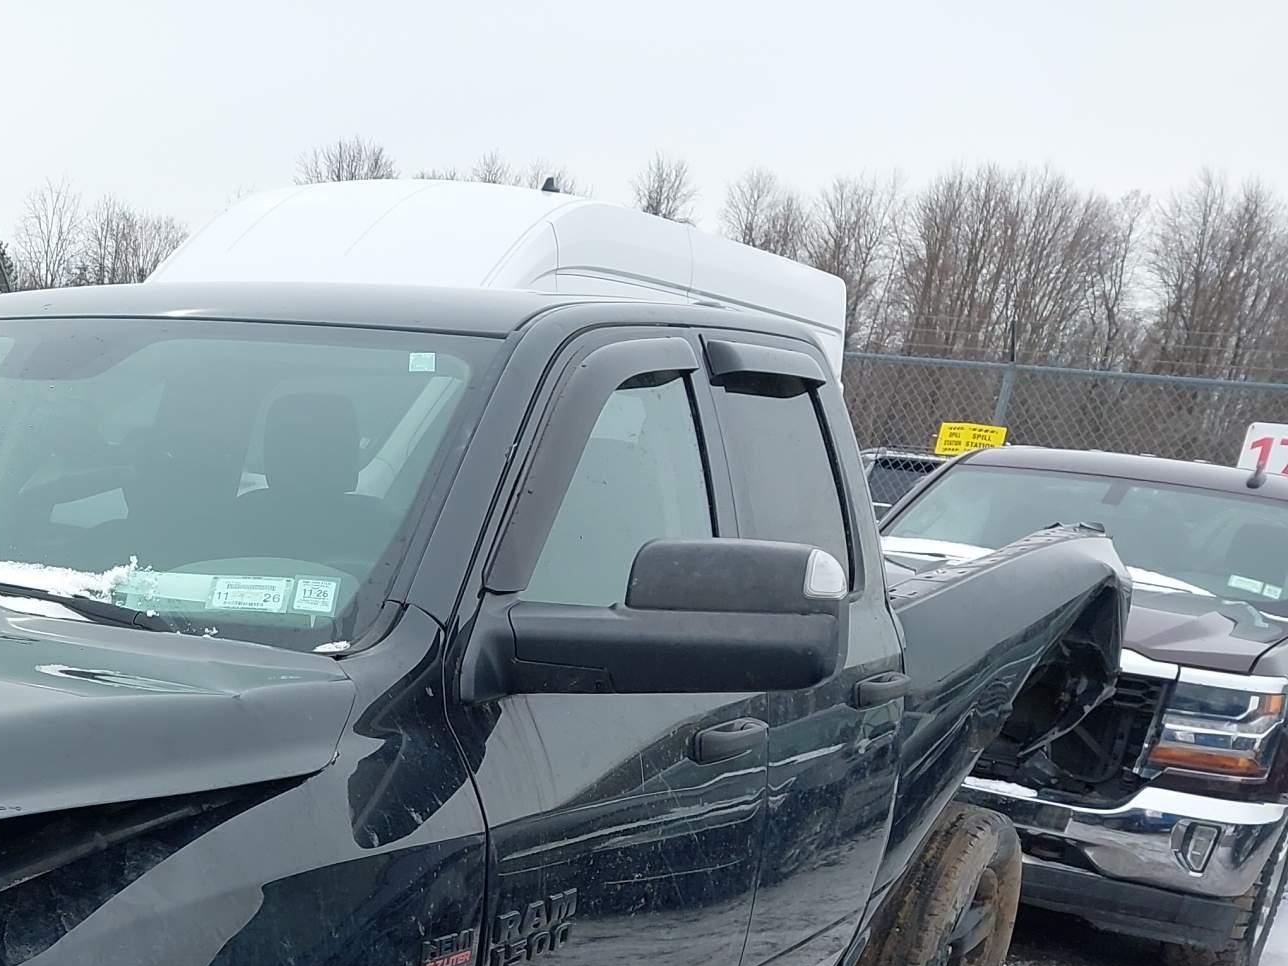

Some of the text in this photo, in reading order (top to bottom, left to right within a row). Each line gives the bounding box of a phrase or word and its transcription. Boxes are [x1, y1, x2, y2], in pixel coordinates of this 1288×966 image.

[1250, 437, 1288, 474] 1
[263, 593, 281, 603] 26
[491, 886, 579, 944] RAM
